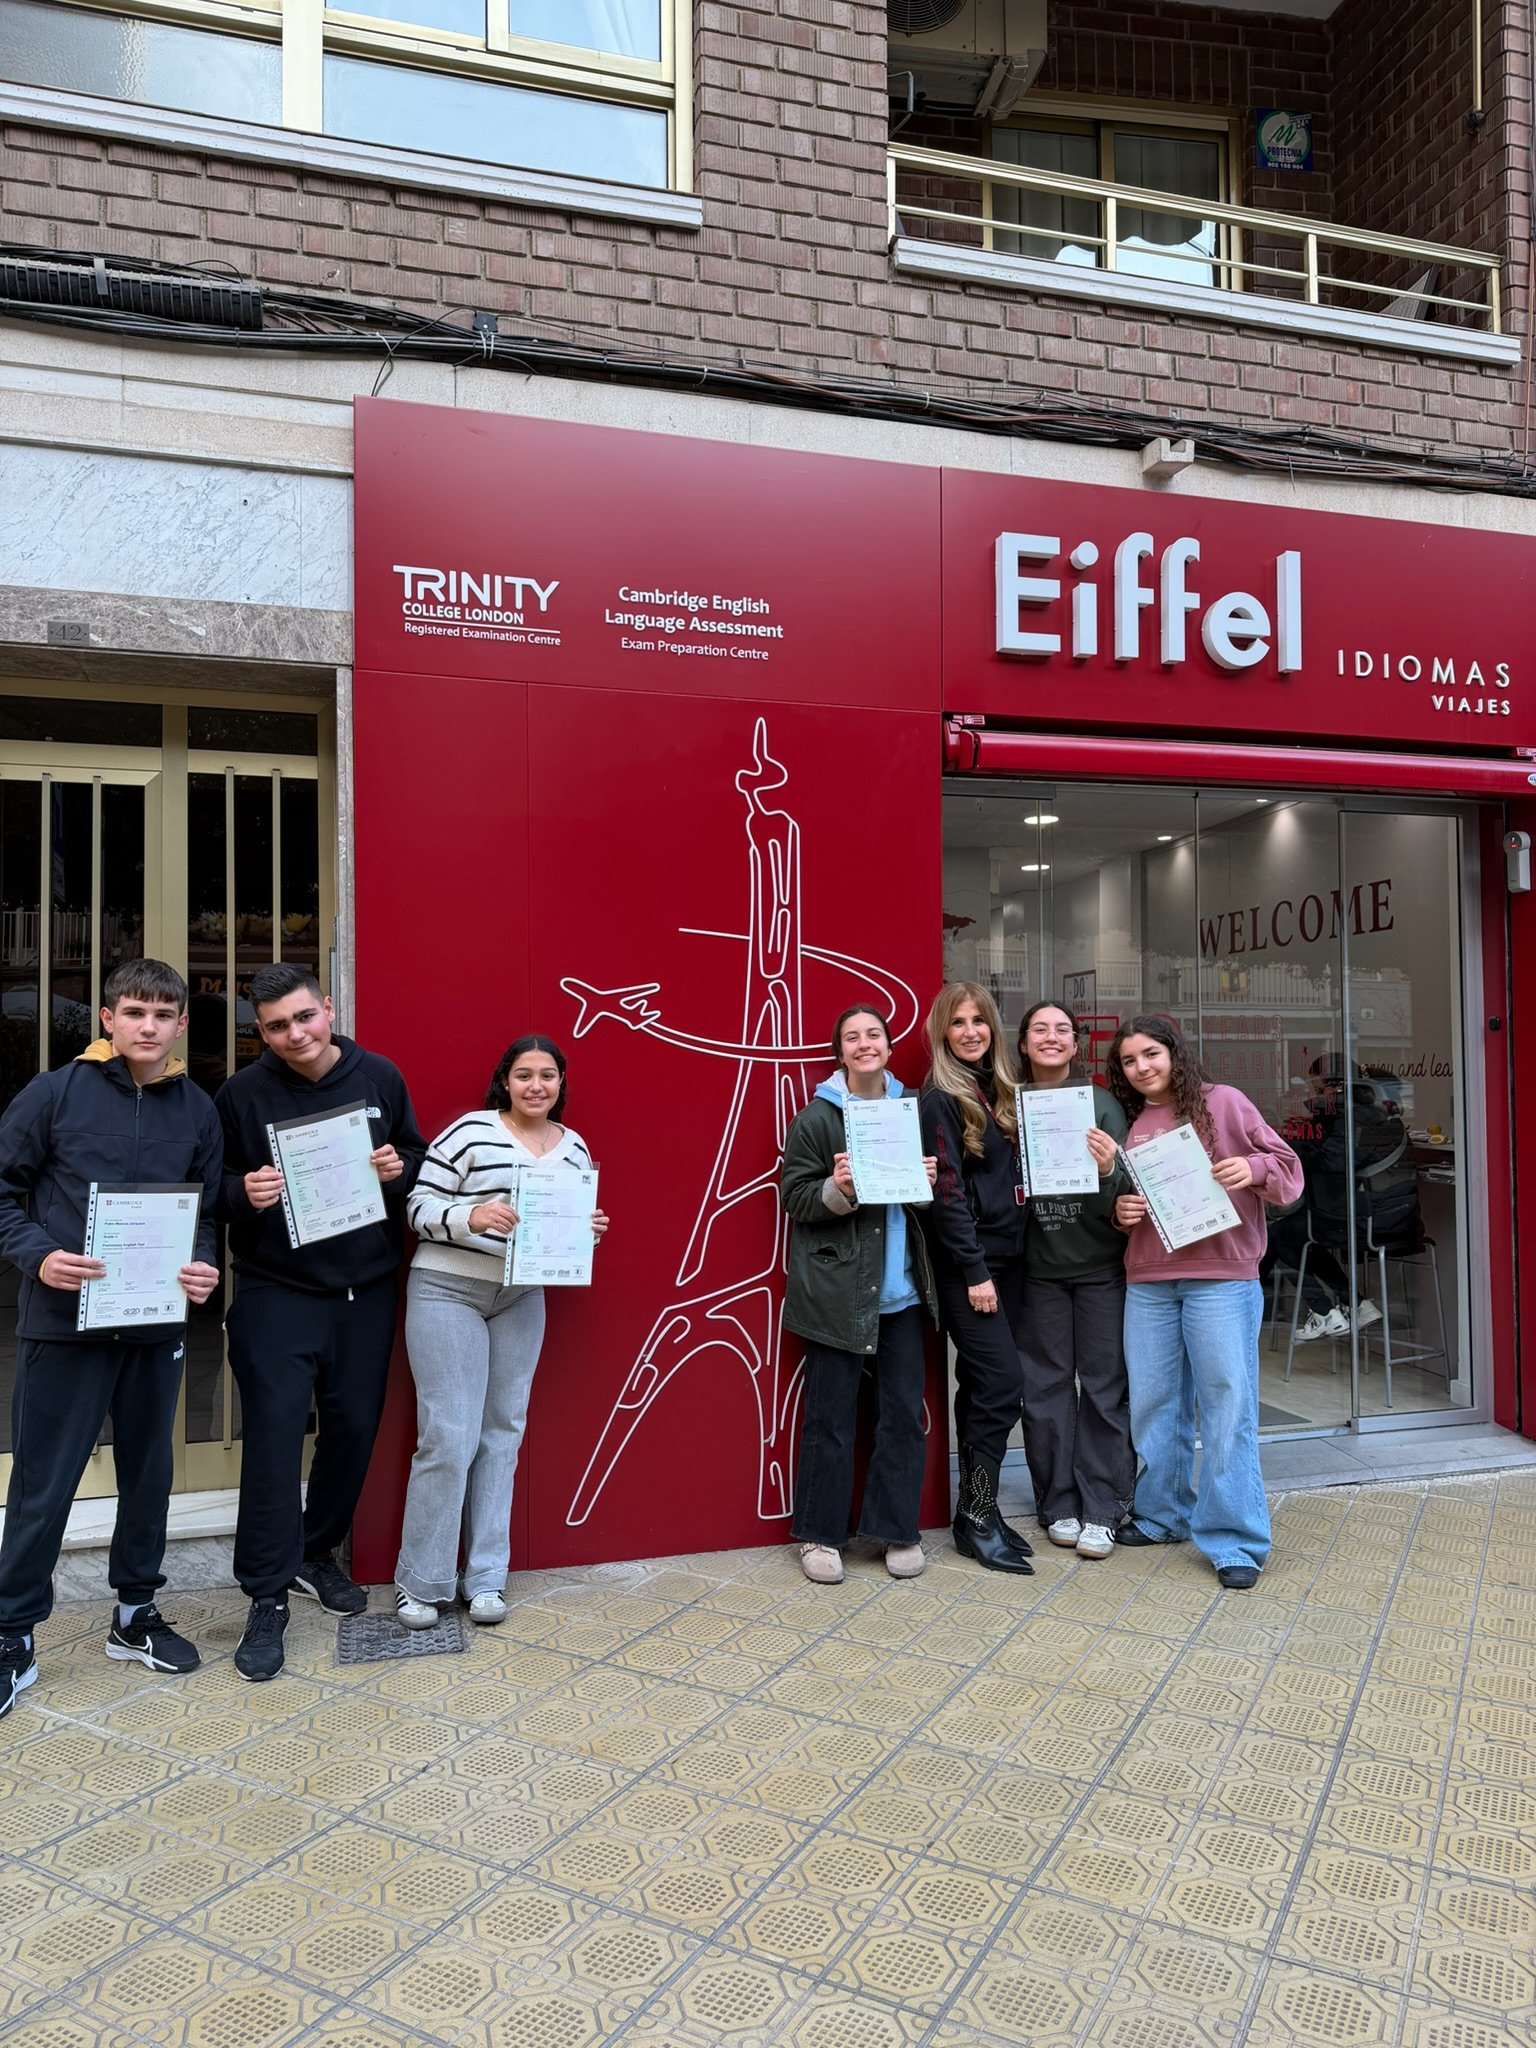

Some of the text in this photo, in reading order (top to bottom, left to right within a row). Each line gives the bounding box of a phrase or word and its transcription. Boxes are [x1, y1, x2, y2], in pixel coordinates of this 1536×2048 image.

[392, 564, 561, 613] TRINITY
[618, 585, 770, 616] Cambridge English
[994, 530, 1303, 674] Eiffel
[402, 601, 525, 626] COLLEGE LONDON
[604, 607, 784, 639] Language Assessment
[56, 623, 82, 641] 42
[404, 621, 562, 646] Registered Examination Centre
[620, 636, 769, 661] Exam Preparation Centre
[1337, 648, 1512, 689] IDIOMAS
[1431, 693, 1512, 717] VIAJES
[1199, 878, 1395, 958] WELCOME
[1203, 1014, 1283, 1042] YEARS
[1398, 1053, 1428, 1077] and
